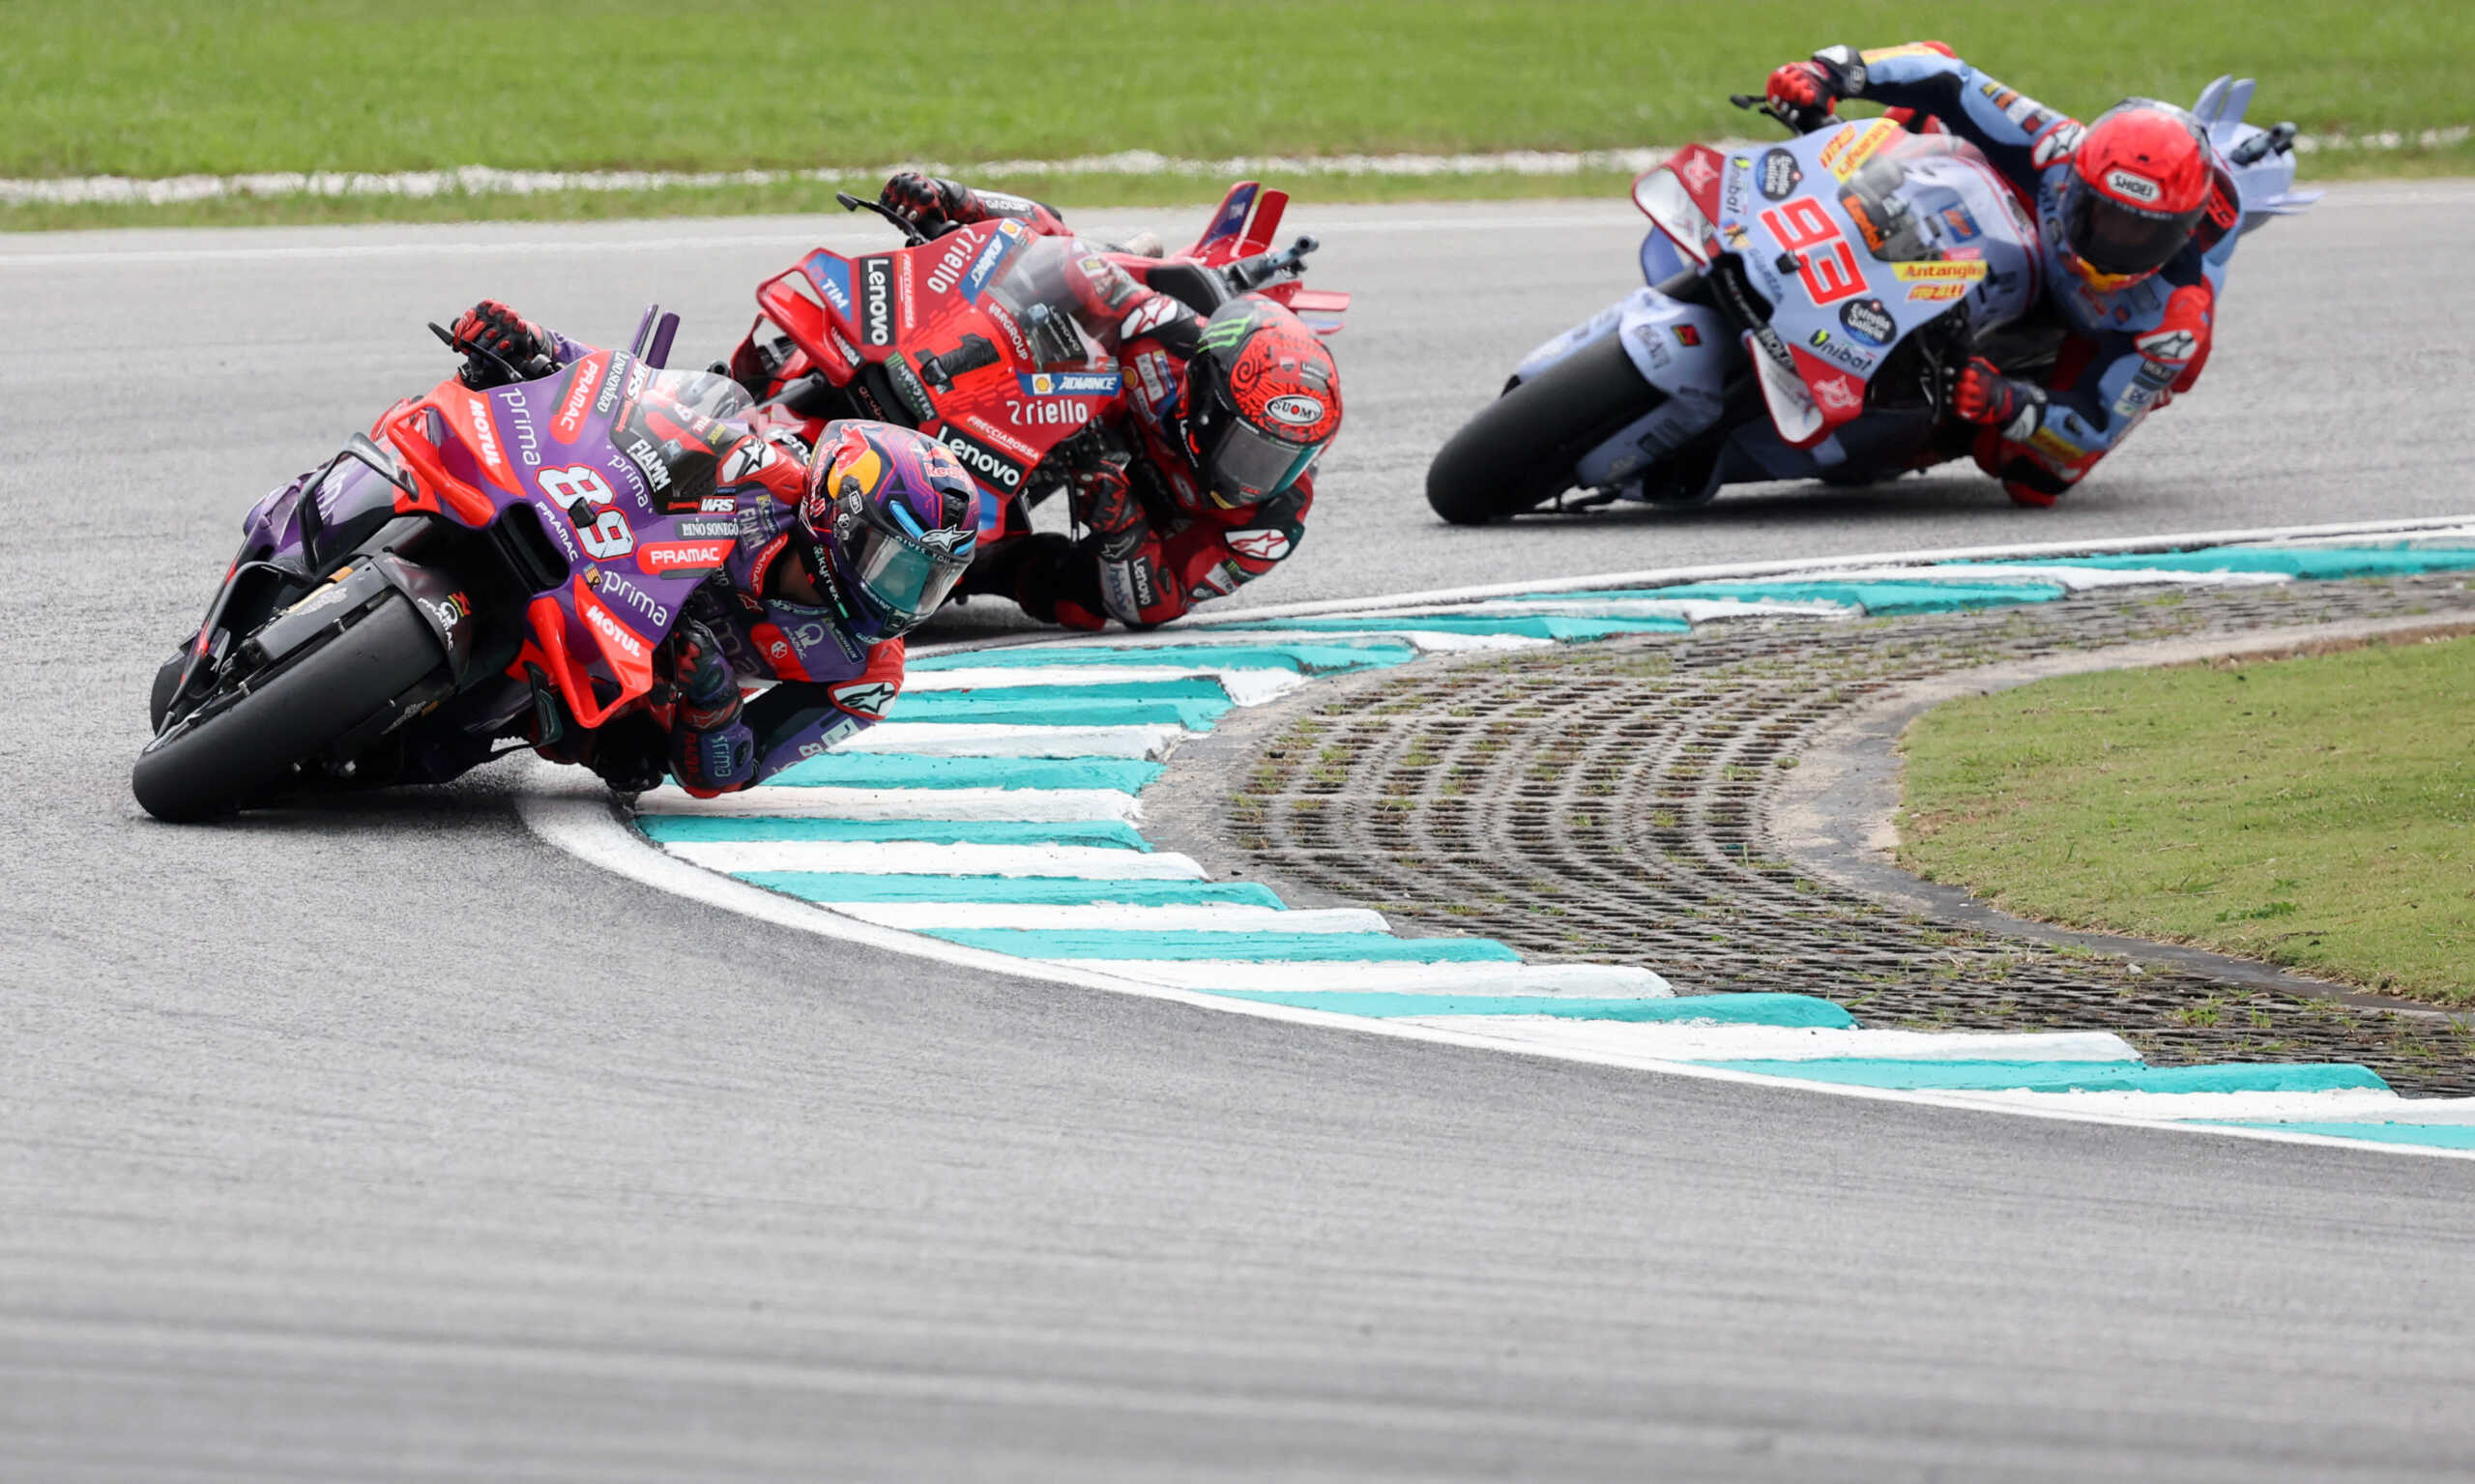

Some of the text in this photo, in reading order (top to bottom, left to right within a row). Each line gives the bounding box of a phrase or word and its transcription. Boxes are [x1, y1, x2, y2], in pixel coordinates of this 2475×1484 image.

[2113, 174, 2152, 196] SHOEI
[1760, 195, 1869, 306] 93
[822, 277, 849, 309] TIM
[867, 258, 889, 346] Lenovo
[560, 360, 598, 432] PRAMAC
[468, 397, 503, 467] MOTUL
[498, 387, 542, 466] prima
[607, 453, 650, 509] prima
[626, 439, 673, 492] FIAMM
[937, 425, 1021, 486] Lenovo
[535, 501, 579, 562] PRAMAC
[536, 464, 636, 561] 89
[699, 498, 736, 512] WRS
[650, 546, 720, 566] PRAMAC
[1132, 555, 1151, 606] Lenovo
[601, 570, 668, 627] prima
[585, 604, 641, 657] MOTUL
